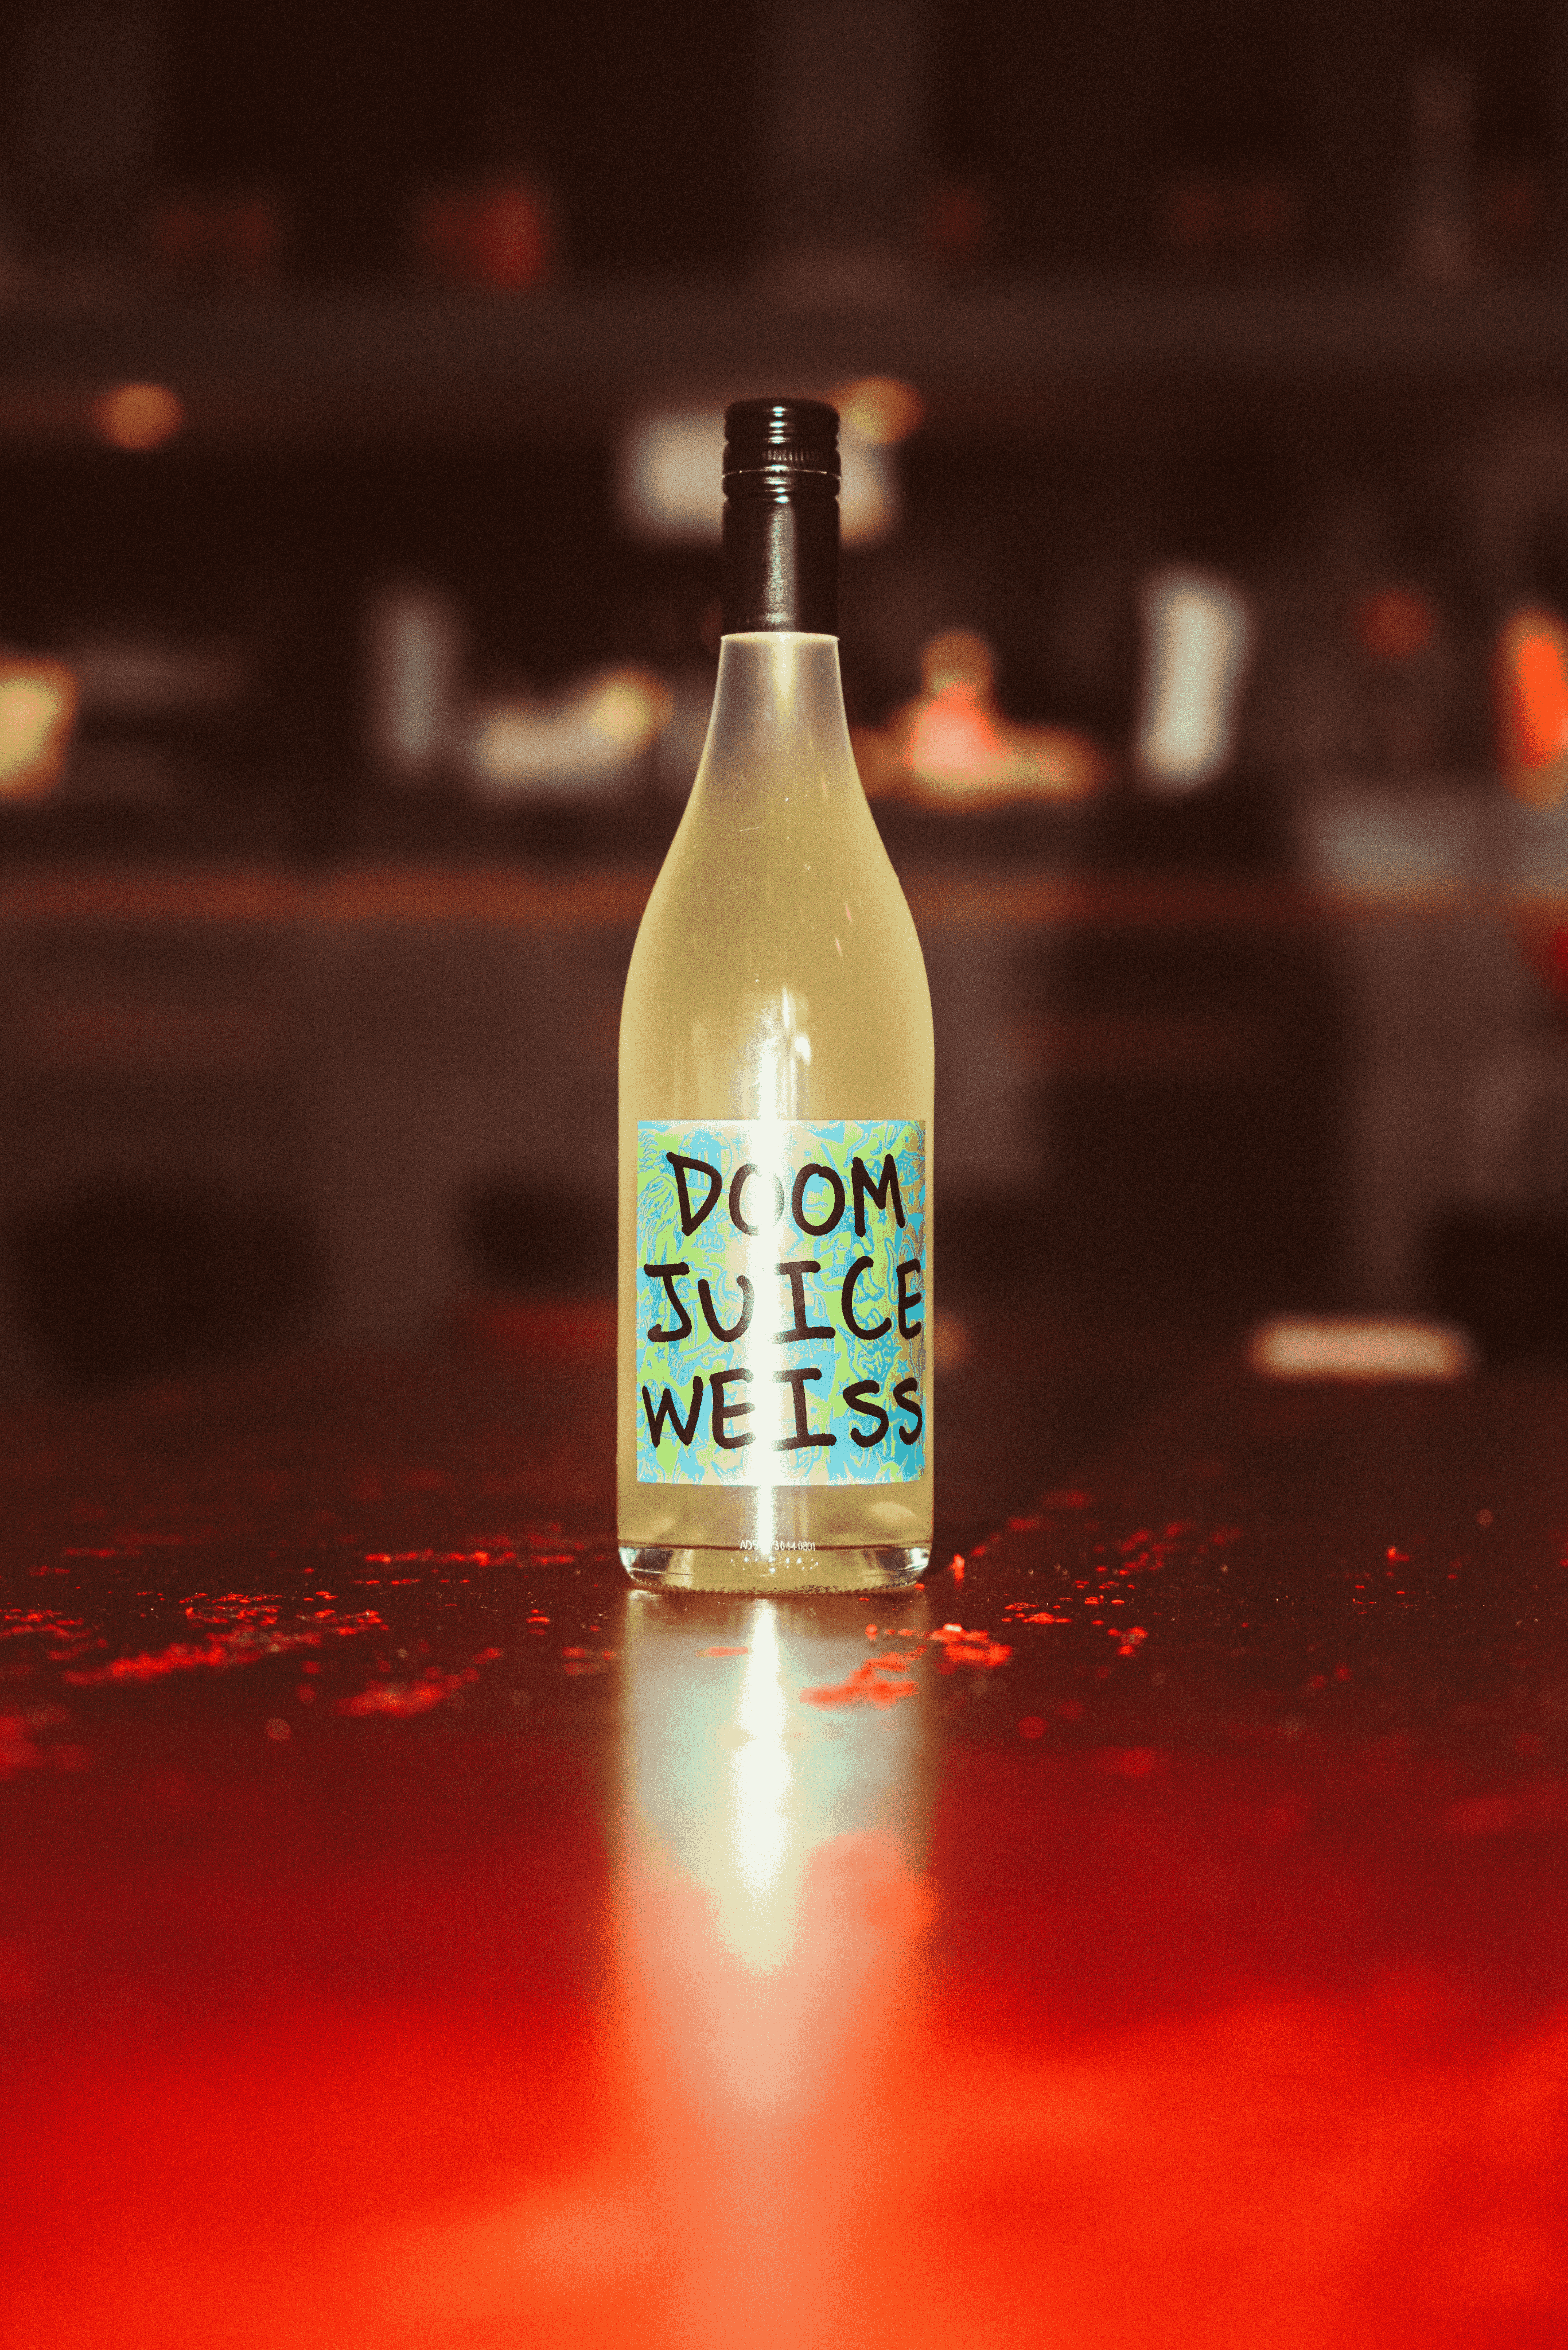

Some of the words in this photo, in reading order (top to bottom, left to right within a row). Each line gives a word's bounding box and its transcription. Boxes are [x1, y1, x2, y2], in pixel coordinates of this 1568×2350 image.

[667, 1151, 905, 1236] DOOM
[644, 1256, 922, 1343] JUICE
[642, 1368, 923, 1450] WEISS
